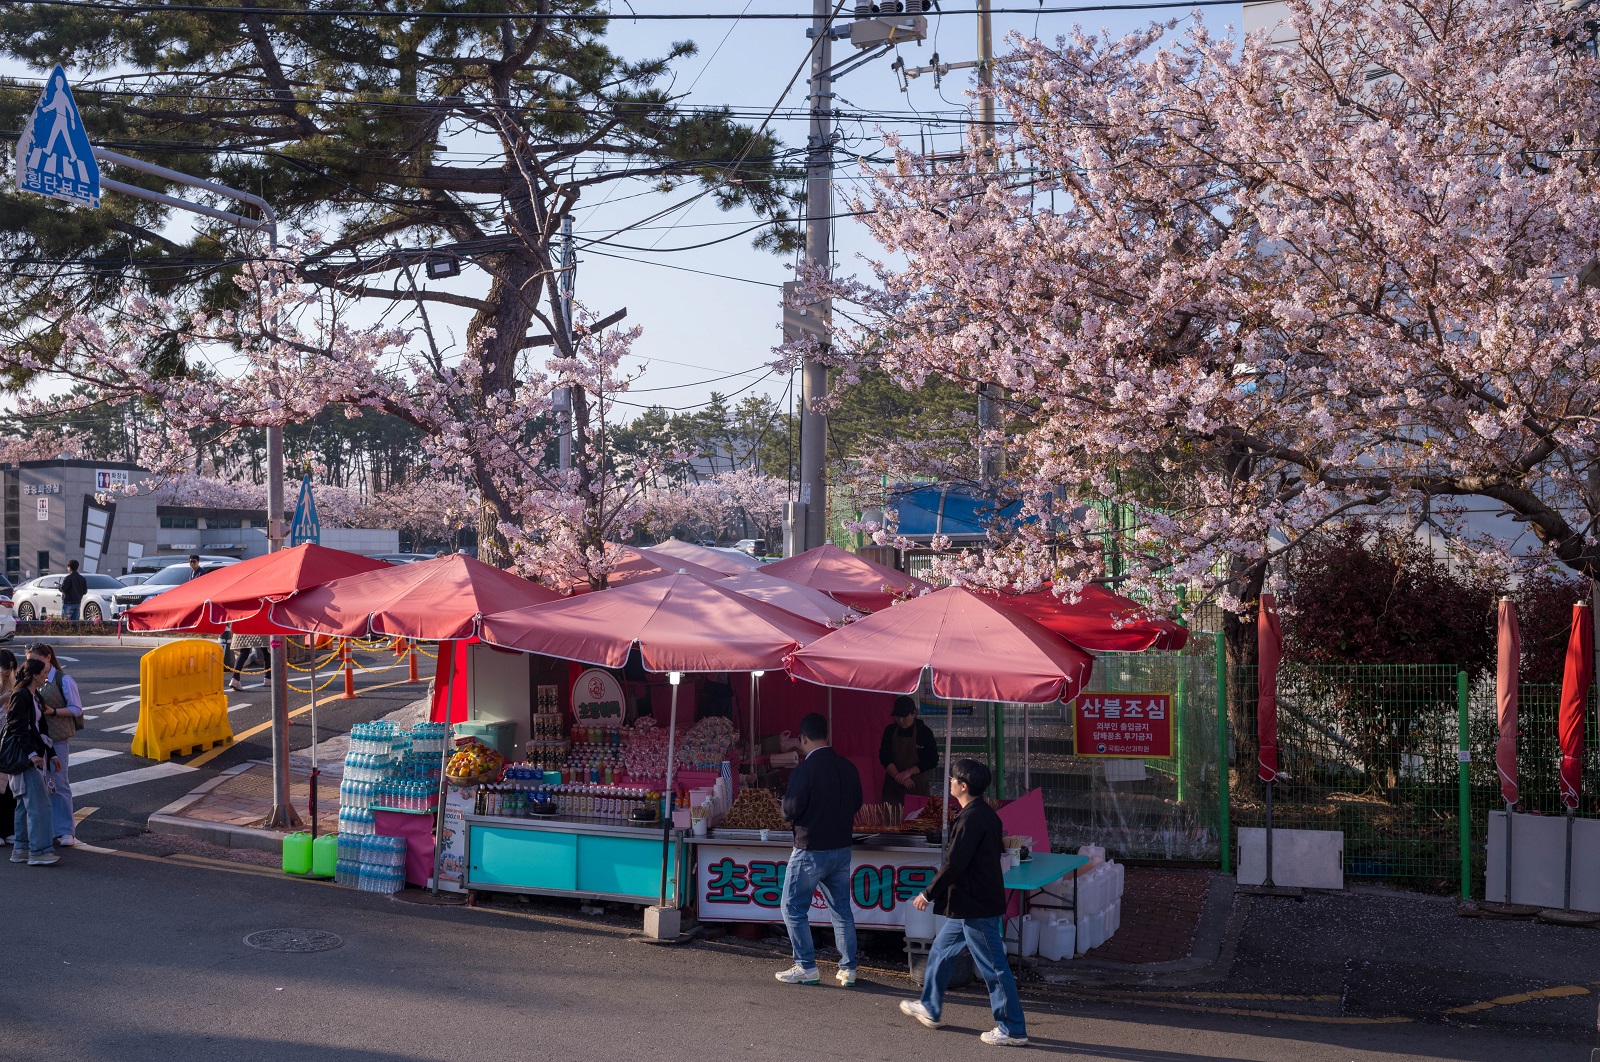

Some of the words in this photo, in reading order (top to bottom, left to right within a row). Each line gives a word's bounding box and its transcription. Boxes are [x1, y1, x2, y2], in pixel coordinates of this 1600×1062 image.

[27, 167, 90, 200] 횡단보도
[23, 483, 60, 494] 공중화장실
[1080, 698, 1165, 720] 산불조심
[1096, 722, 1118, 731] 외부인
[1120, 722, 1149, 731] 출입금지
[1093, 732, 1121, 740] 담배꽁초
[1124, 733, 1152, 741] 투기금지
